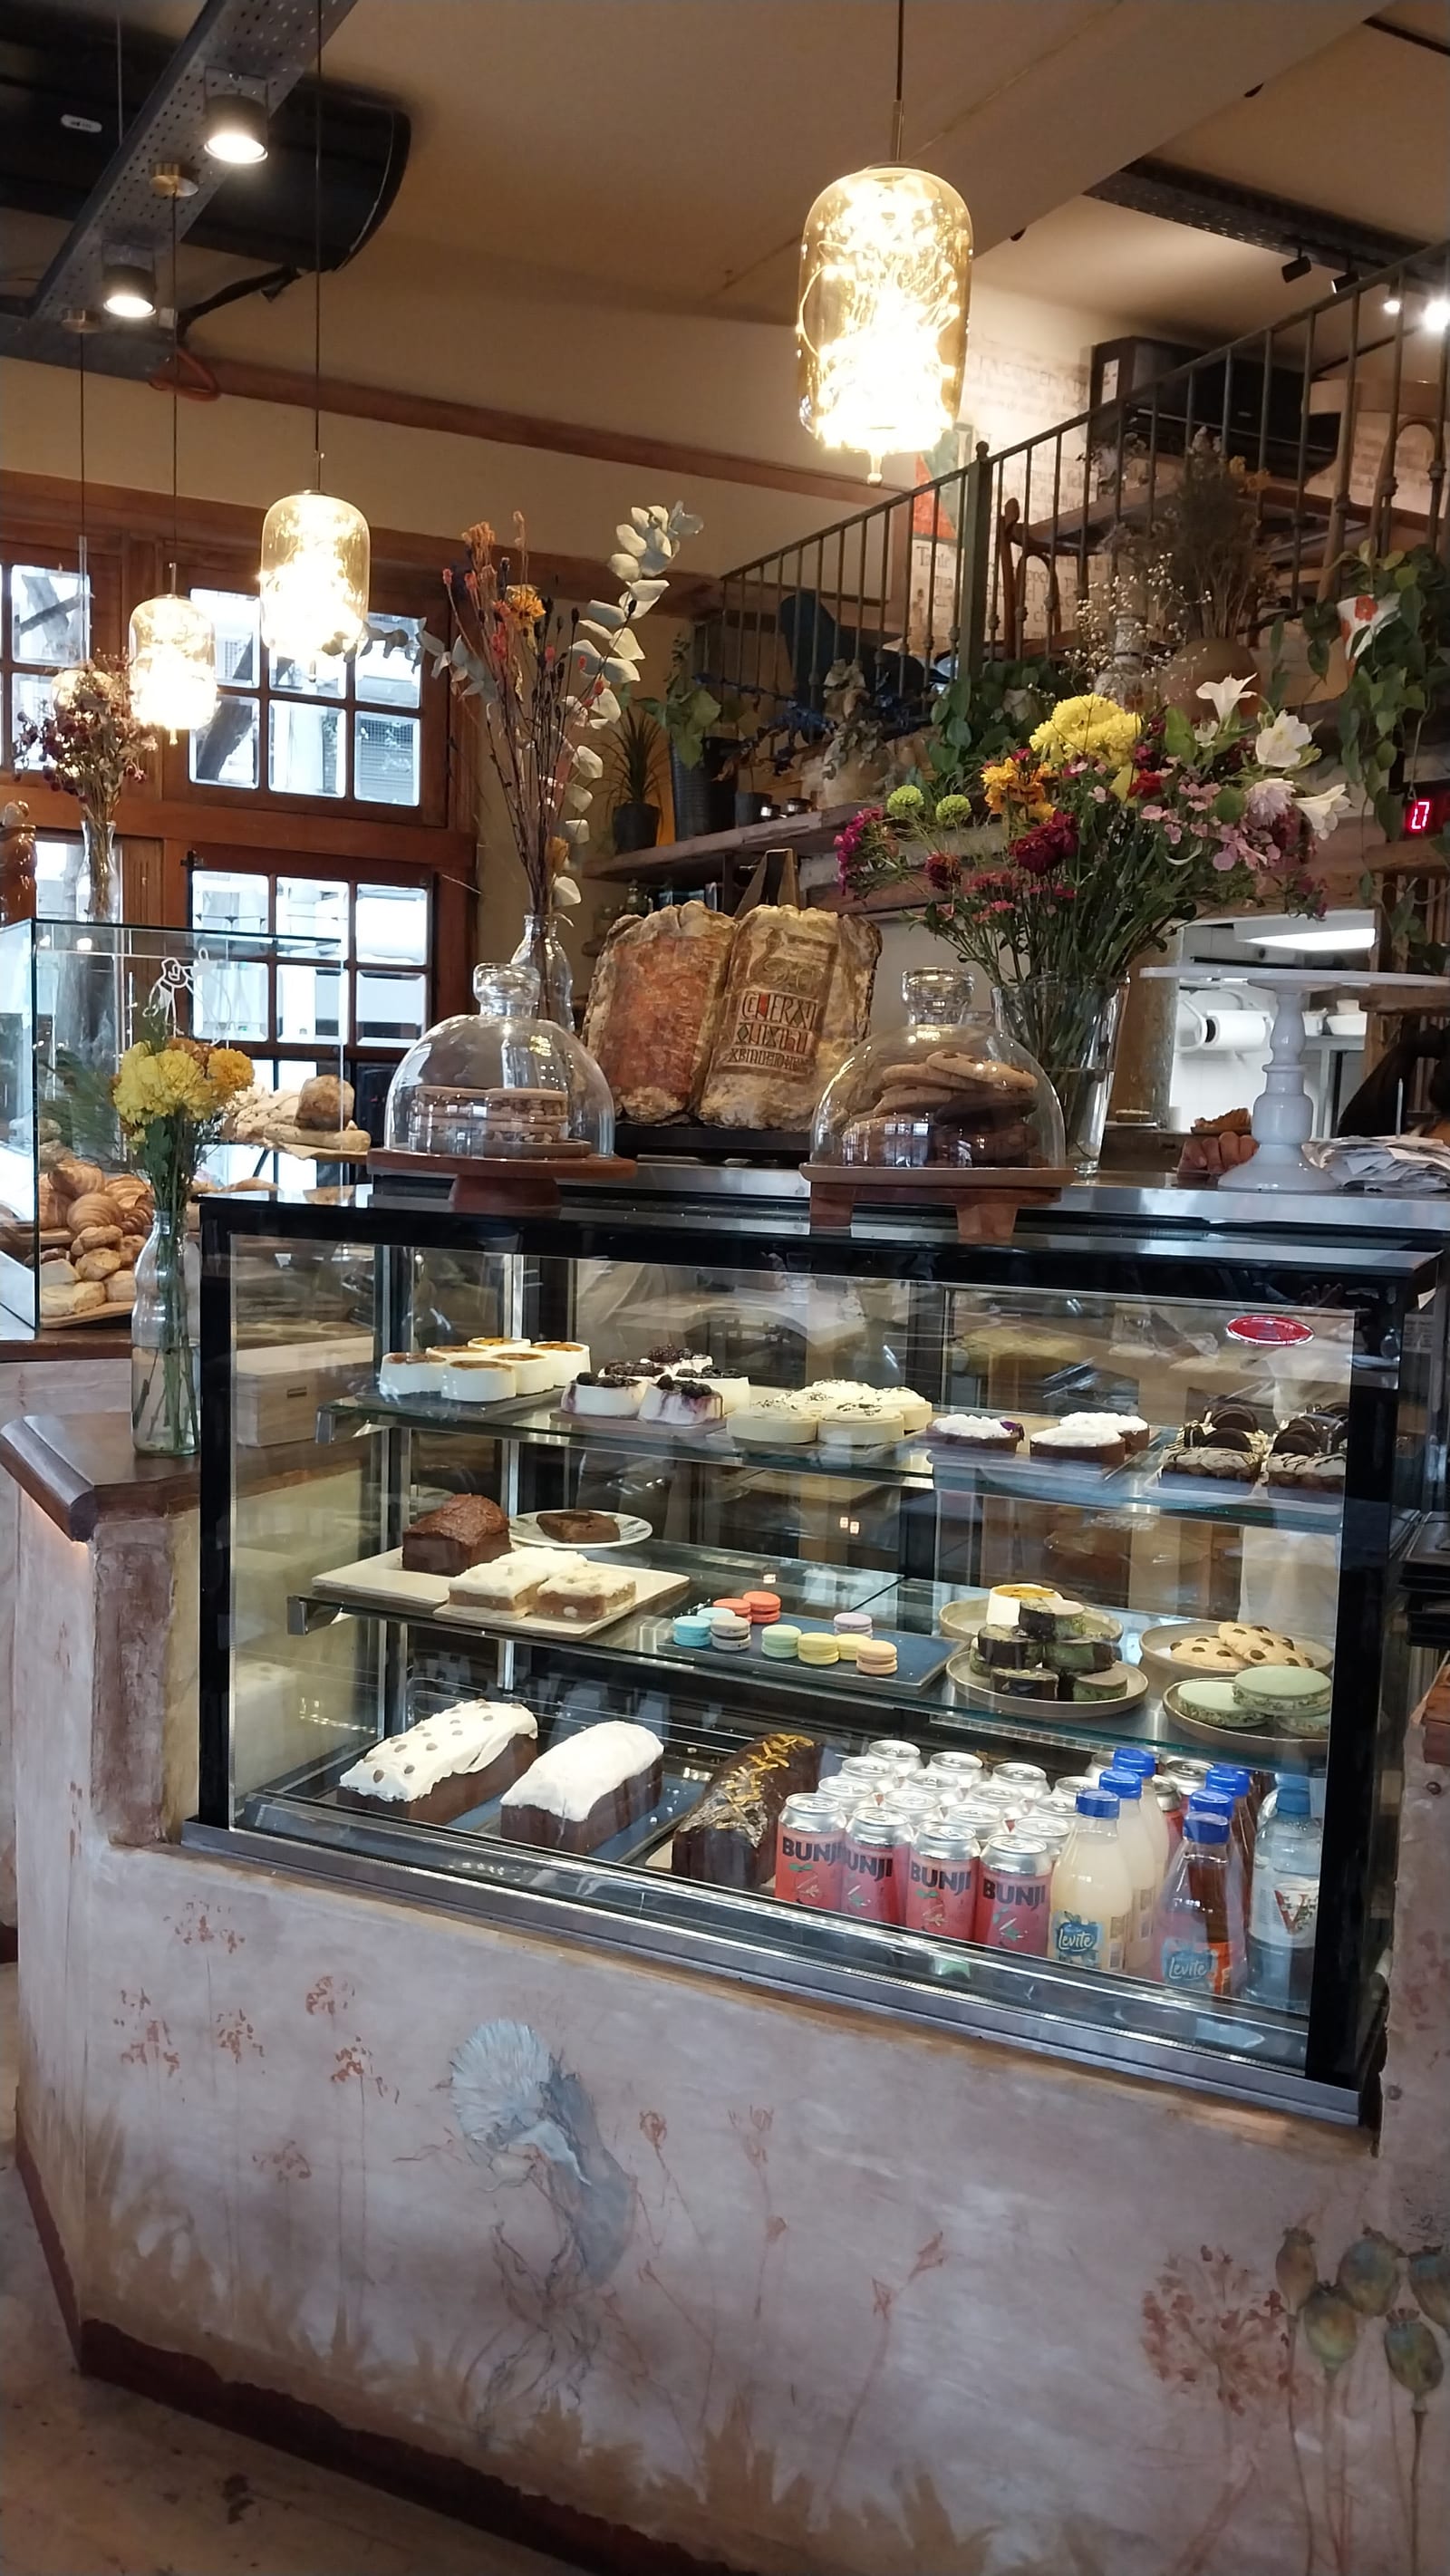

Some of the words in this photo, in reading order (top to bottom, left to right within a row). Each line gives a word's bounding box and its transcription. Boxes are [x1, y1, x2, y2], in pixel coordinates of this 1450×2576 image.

[848, 1850, 893, 1882] UNJI
[910, 1860, 972, 1896] BUNJI
[983, 1877, 1046, 1911] BUNJI
